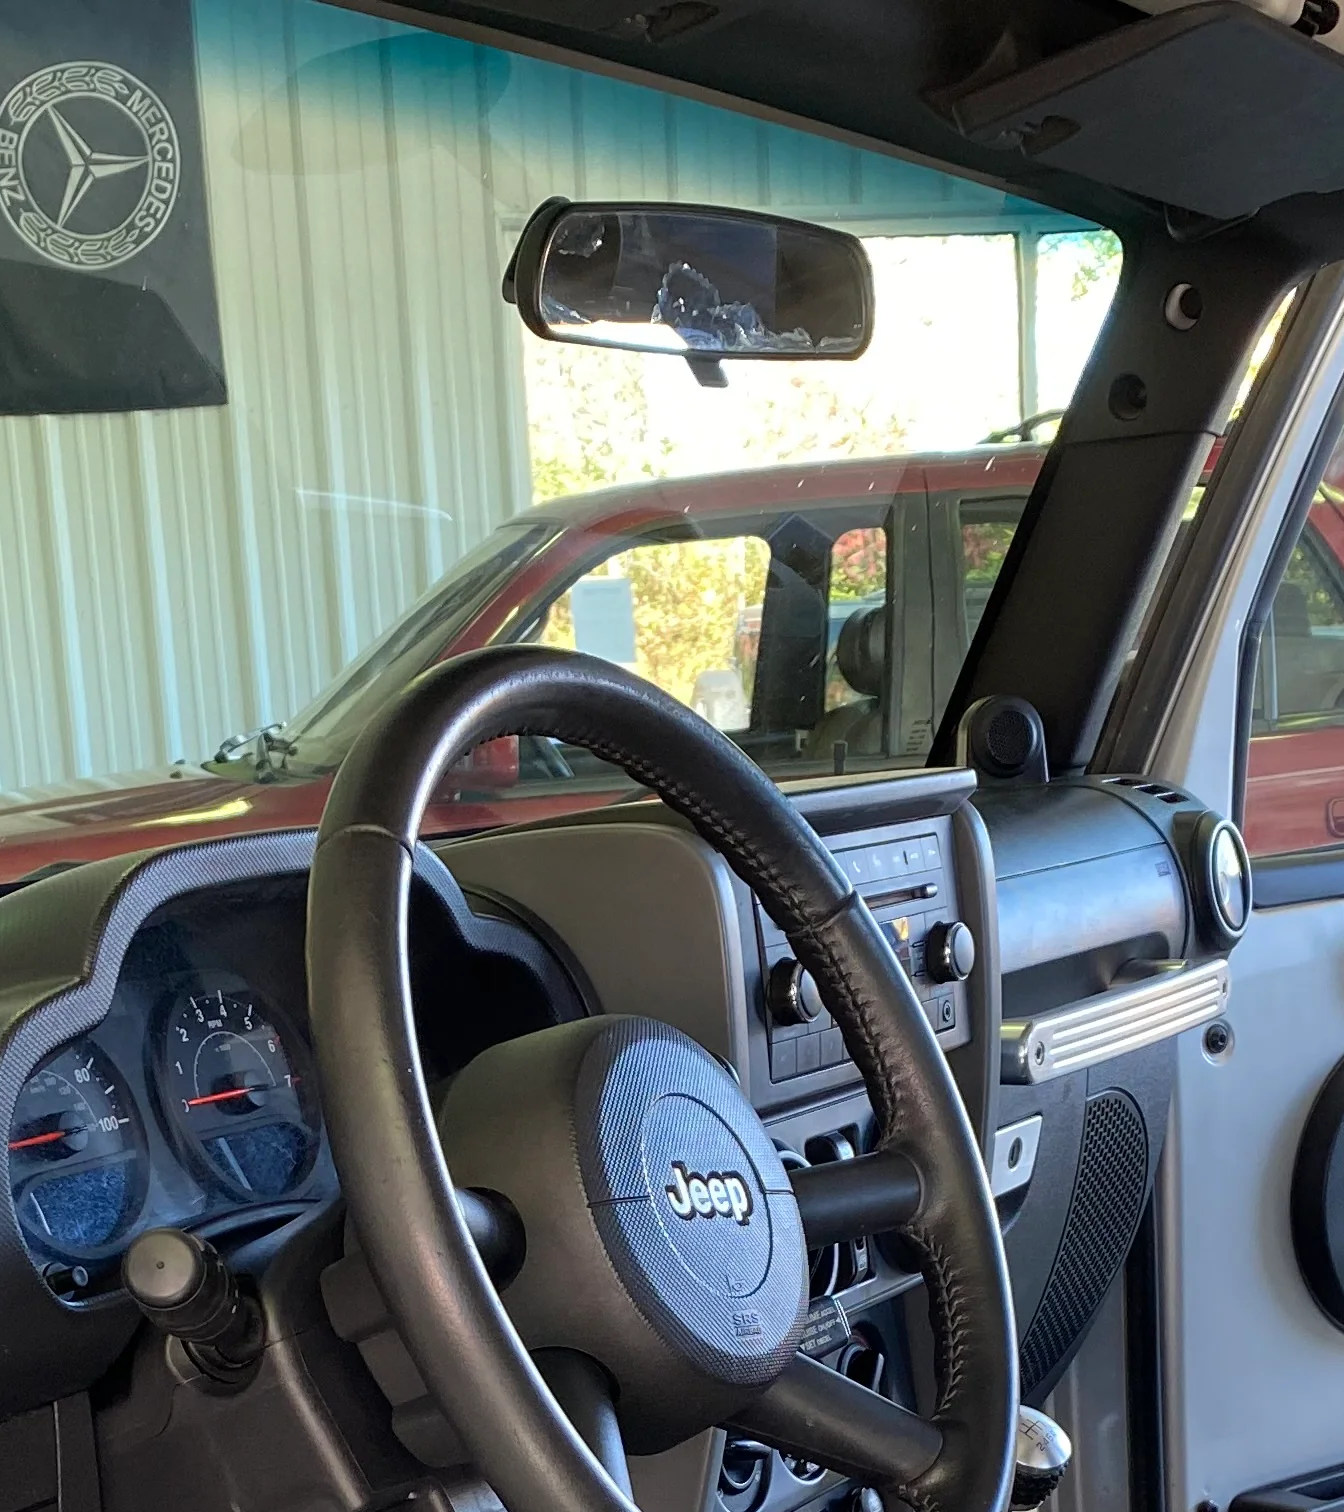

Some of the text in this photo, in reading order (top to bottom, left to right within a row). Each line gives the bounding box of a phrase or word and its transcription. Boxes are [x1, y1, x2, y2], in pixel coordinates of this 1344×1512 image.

[126, 89, 175, 234] MERCEDES
[196, 1009, 204, 1023] 3
[244, 1016, 252, 1030] 5
[179, 1028, 189, 1042] 2
[74, 1067, 91, 1084] 80
[98, 1115, 119, 1132] 100
[666, 1160, 753, 1226] Jeep
